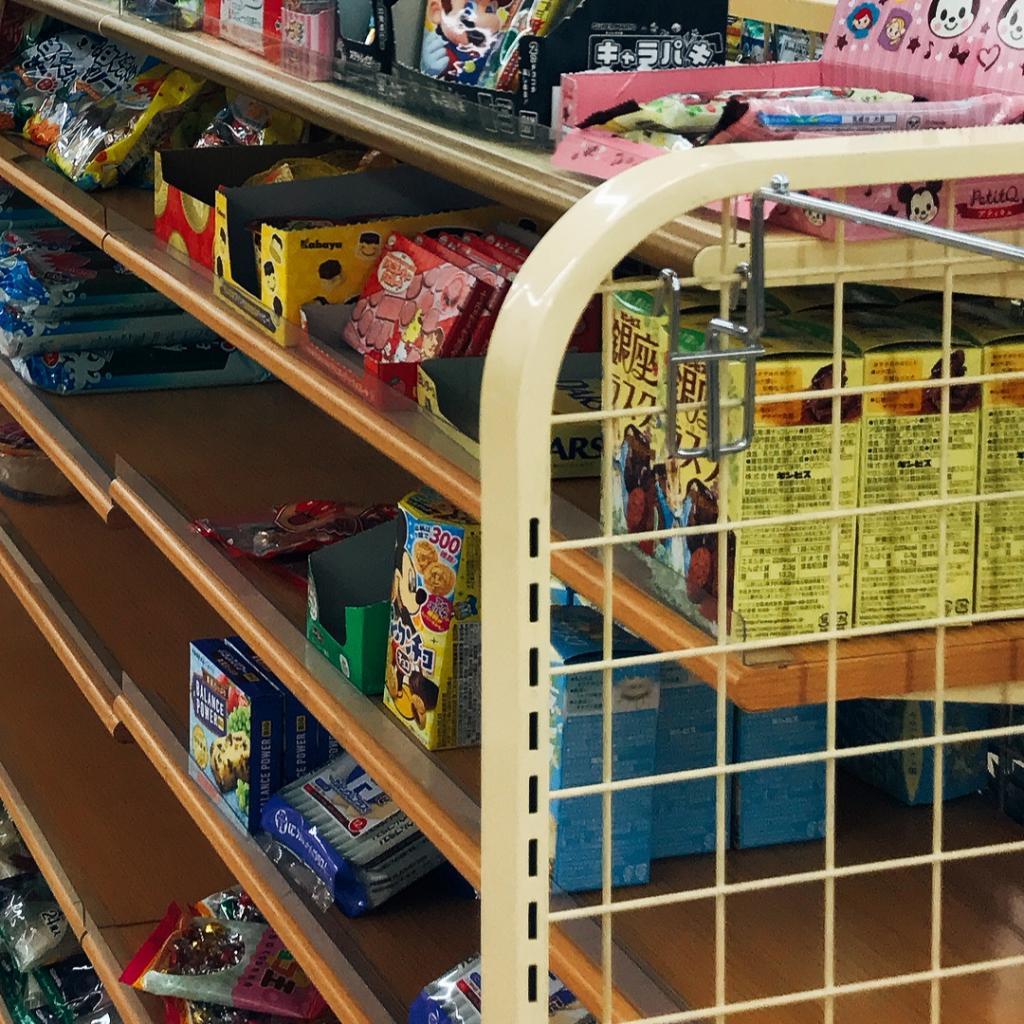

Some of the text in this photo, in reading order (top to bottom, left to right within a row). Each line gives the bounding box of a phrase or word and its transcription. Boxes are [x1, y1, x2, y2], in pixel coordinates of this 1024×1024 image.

[595, 39, 717, 68] キャラパキ
[301, 238, 343, 250] Kabaya
[550, 436, 604, 461] ARS
[428, 527, 462, 555] 300
[195, 679, 225, 717] BALANCE
[195, 698, 218, 727] POWER
[259, 738, 272, 775] POWER
[296, 732, 307, 767] POWER
